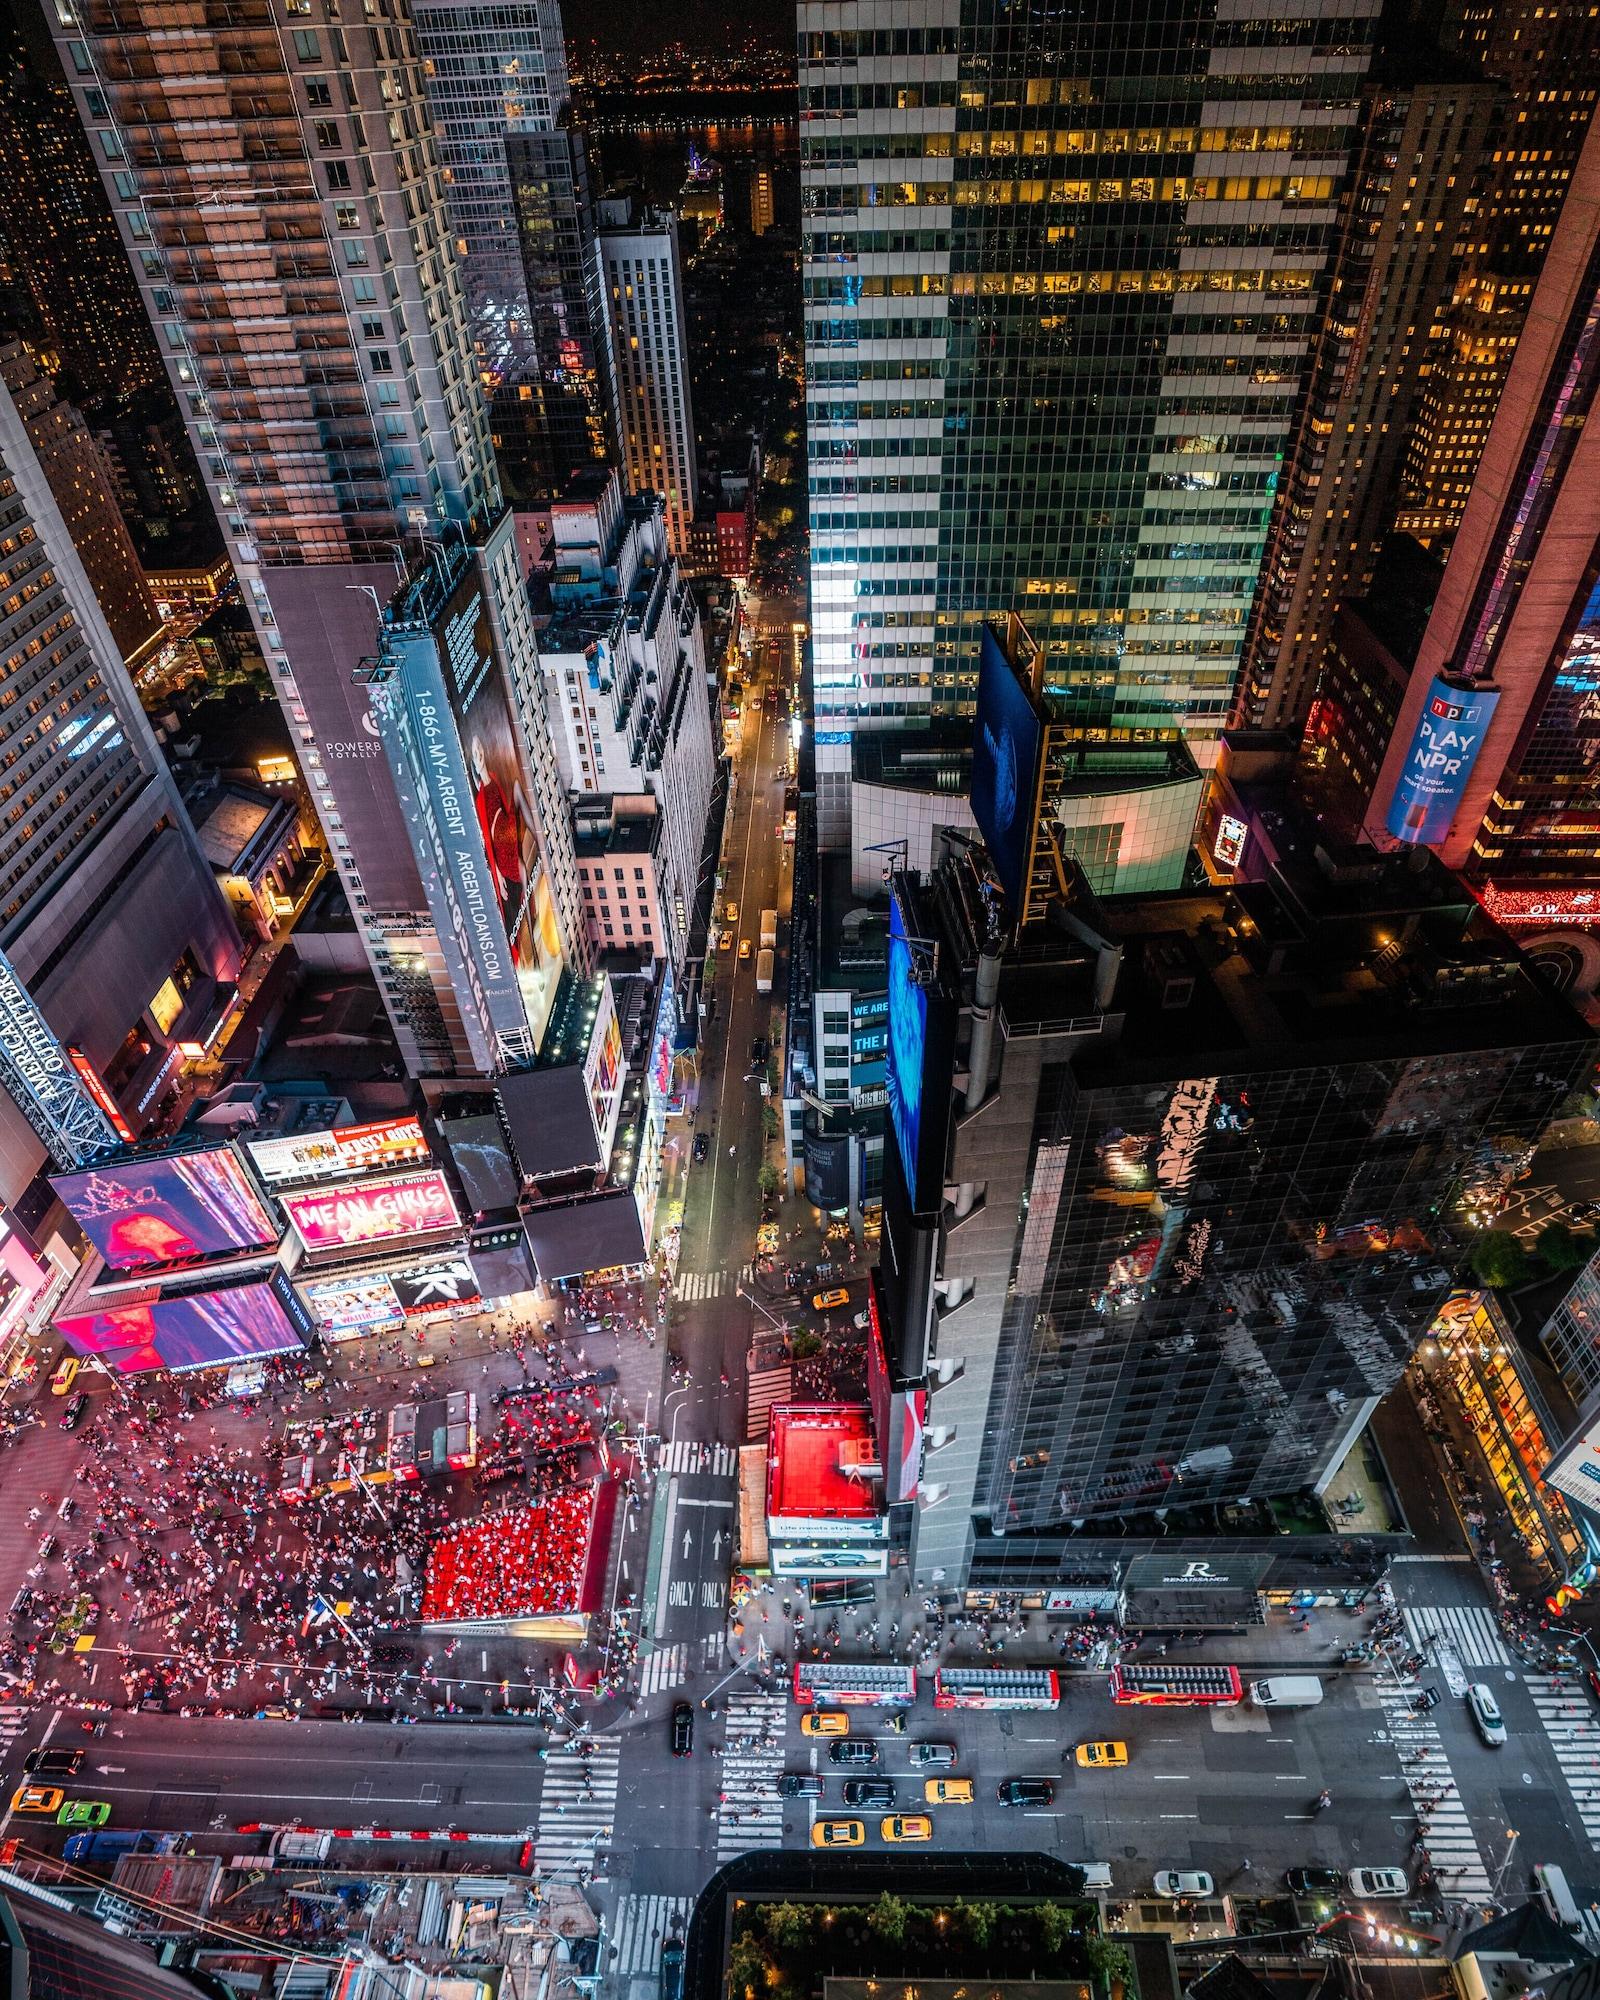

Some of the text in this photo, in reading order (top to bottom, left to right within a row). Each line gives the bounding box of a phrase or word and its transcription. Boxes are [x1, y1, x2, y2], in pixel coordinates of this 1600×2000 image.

[1434, 701, 1475, 720] npr
[329, 751, 378, 759] TOTALLY
[415, 689, 466, 837] 1-866-MY-ARGENT
[1414, 773, 1445, 787] on your
[1421, 785, 1455, 795] speaker.
[455, 850, 503, 980] ARGENTLOANS.COM
[676, 901, 687, 935] HOTEL
[853, 1001, 889, 1017] WE ARE
[854, 1036, 880, 1051] THE
[855, 1092, 874, 1107] 1585
[385, 1122, 424, 1141] BOYS
[308, 1190, 336, 1200] KNOW
[338, 1187, 357, 1196] YOU
[358, 1181, 392, 1193] WANNA
[392, 1179, 404, 1187] SIT
[404, 1176, 426, 1185] WITH
[426, 1174, 438, 1182] US
[297, 1185, 446, 1230] MEAN GIRLS
[277, 1276, 291, 1300] EAGLE
[1181, 1562, 1217, 1578] R
[669, 1581, 727, 1608] ONLY ONLY
